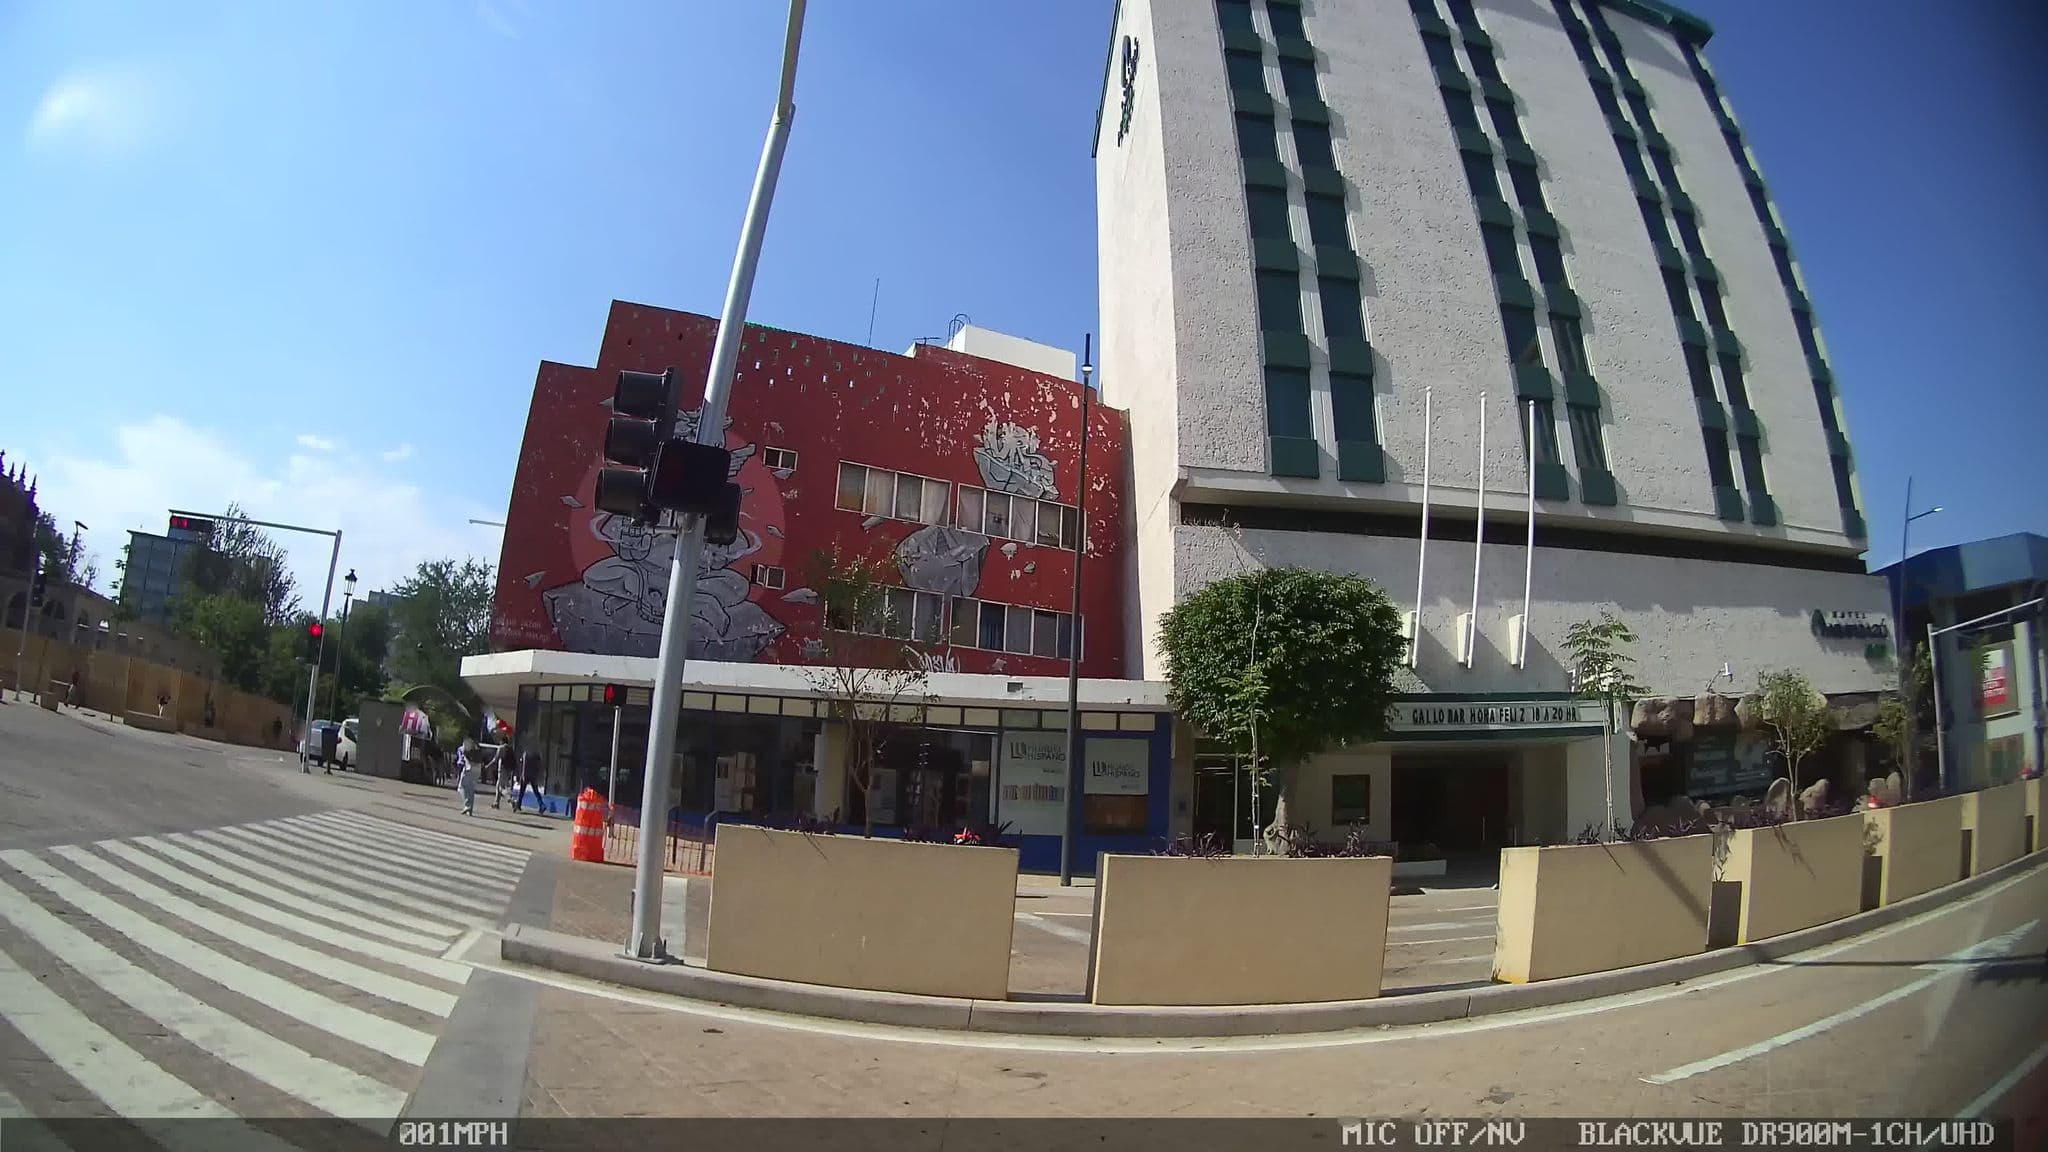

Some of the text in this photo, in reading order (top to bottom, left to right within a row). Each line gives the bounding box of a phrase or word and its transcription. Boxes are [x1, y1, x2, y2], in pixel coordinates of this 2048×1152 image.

[1412, 707, 1445, 725] GALLO
[1447, 707, 1466, 724] BAR
[1469, 707, 1495, 723] HORA
[1543, 707, 1550, 721] A
[1552, 706, 1563, 721] 20
